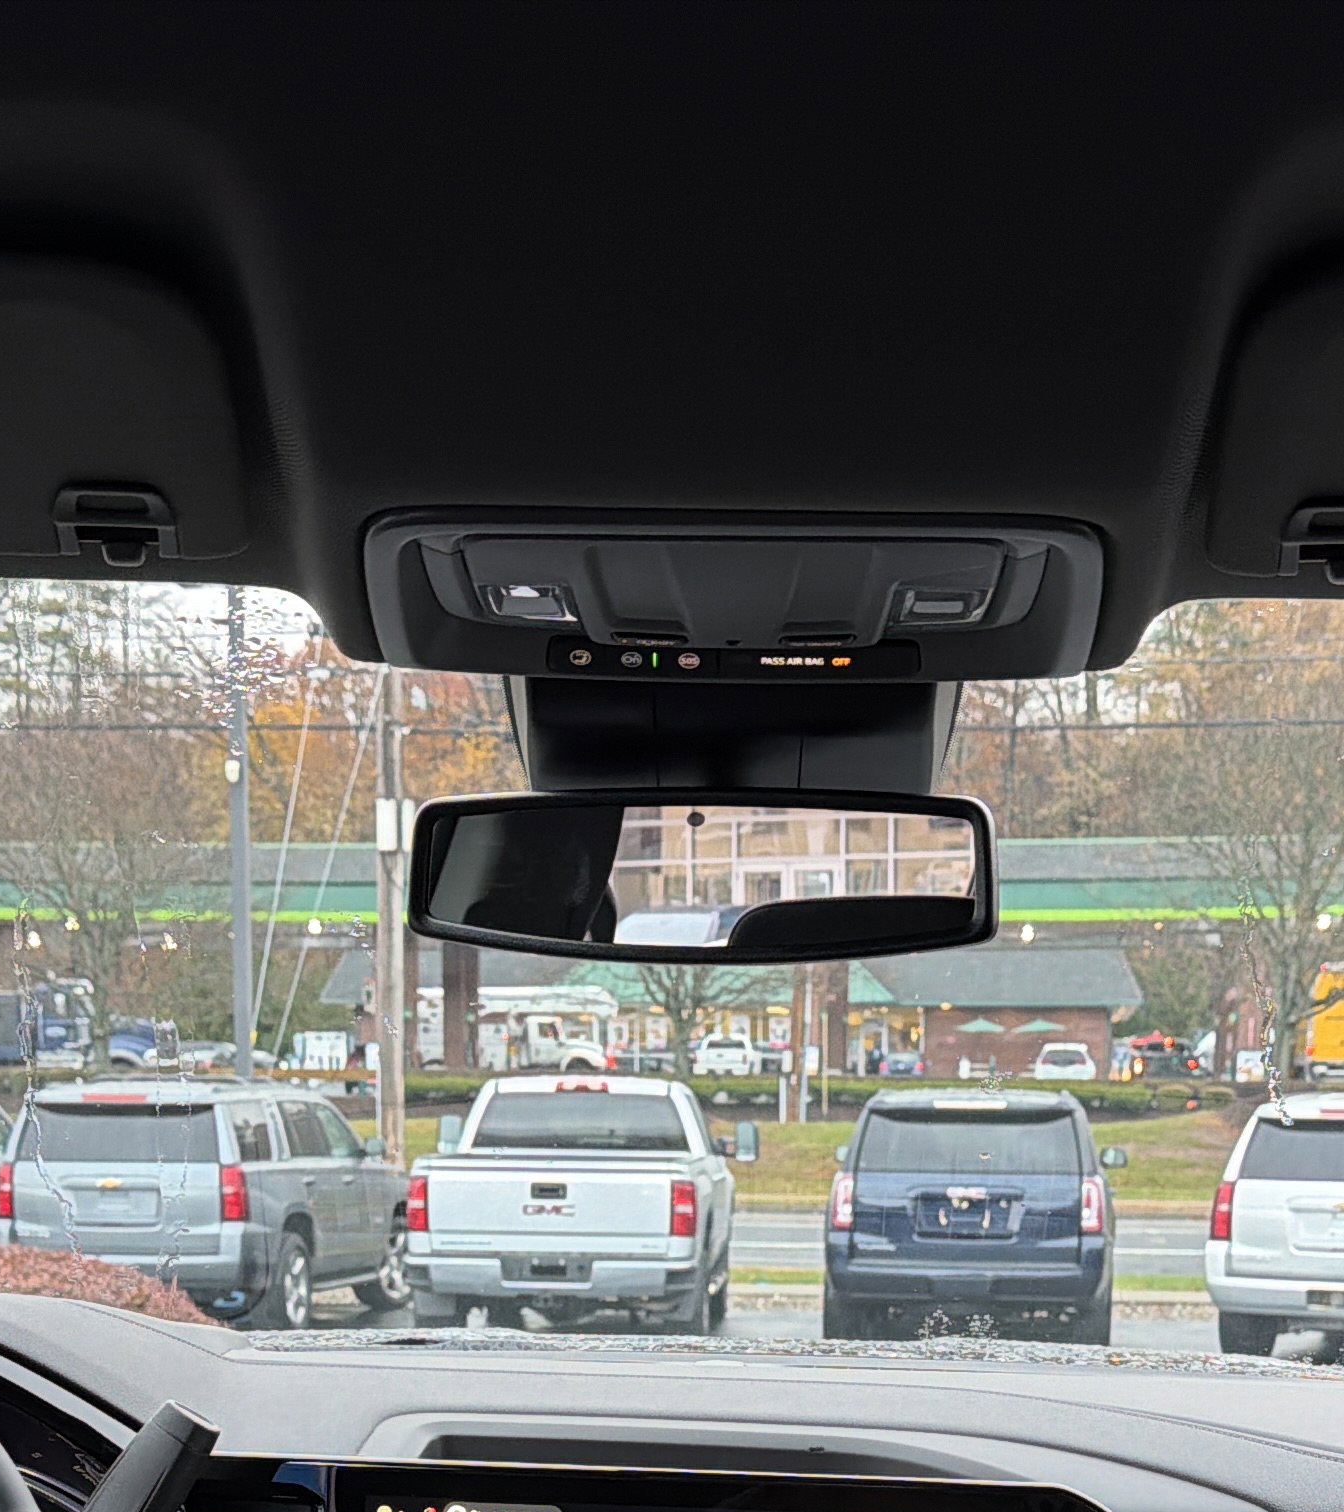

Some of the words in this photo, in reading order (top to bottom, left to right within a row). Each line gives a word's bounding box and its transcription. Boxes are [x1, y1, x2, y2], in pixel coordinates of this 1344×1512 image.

[760, 656, 785, 666] PASS
[787, 656, 803, 666] AIR
[805, 656, 825, 667] BAG
[831, 656, 851, 668] OFF
[522, 1204, 576, 1217] GMC
